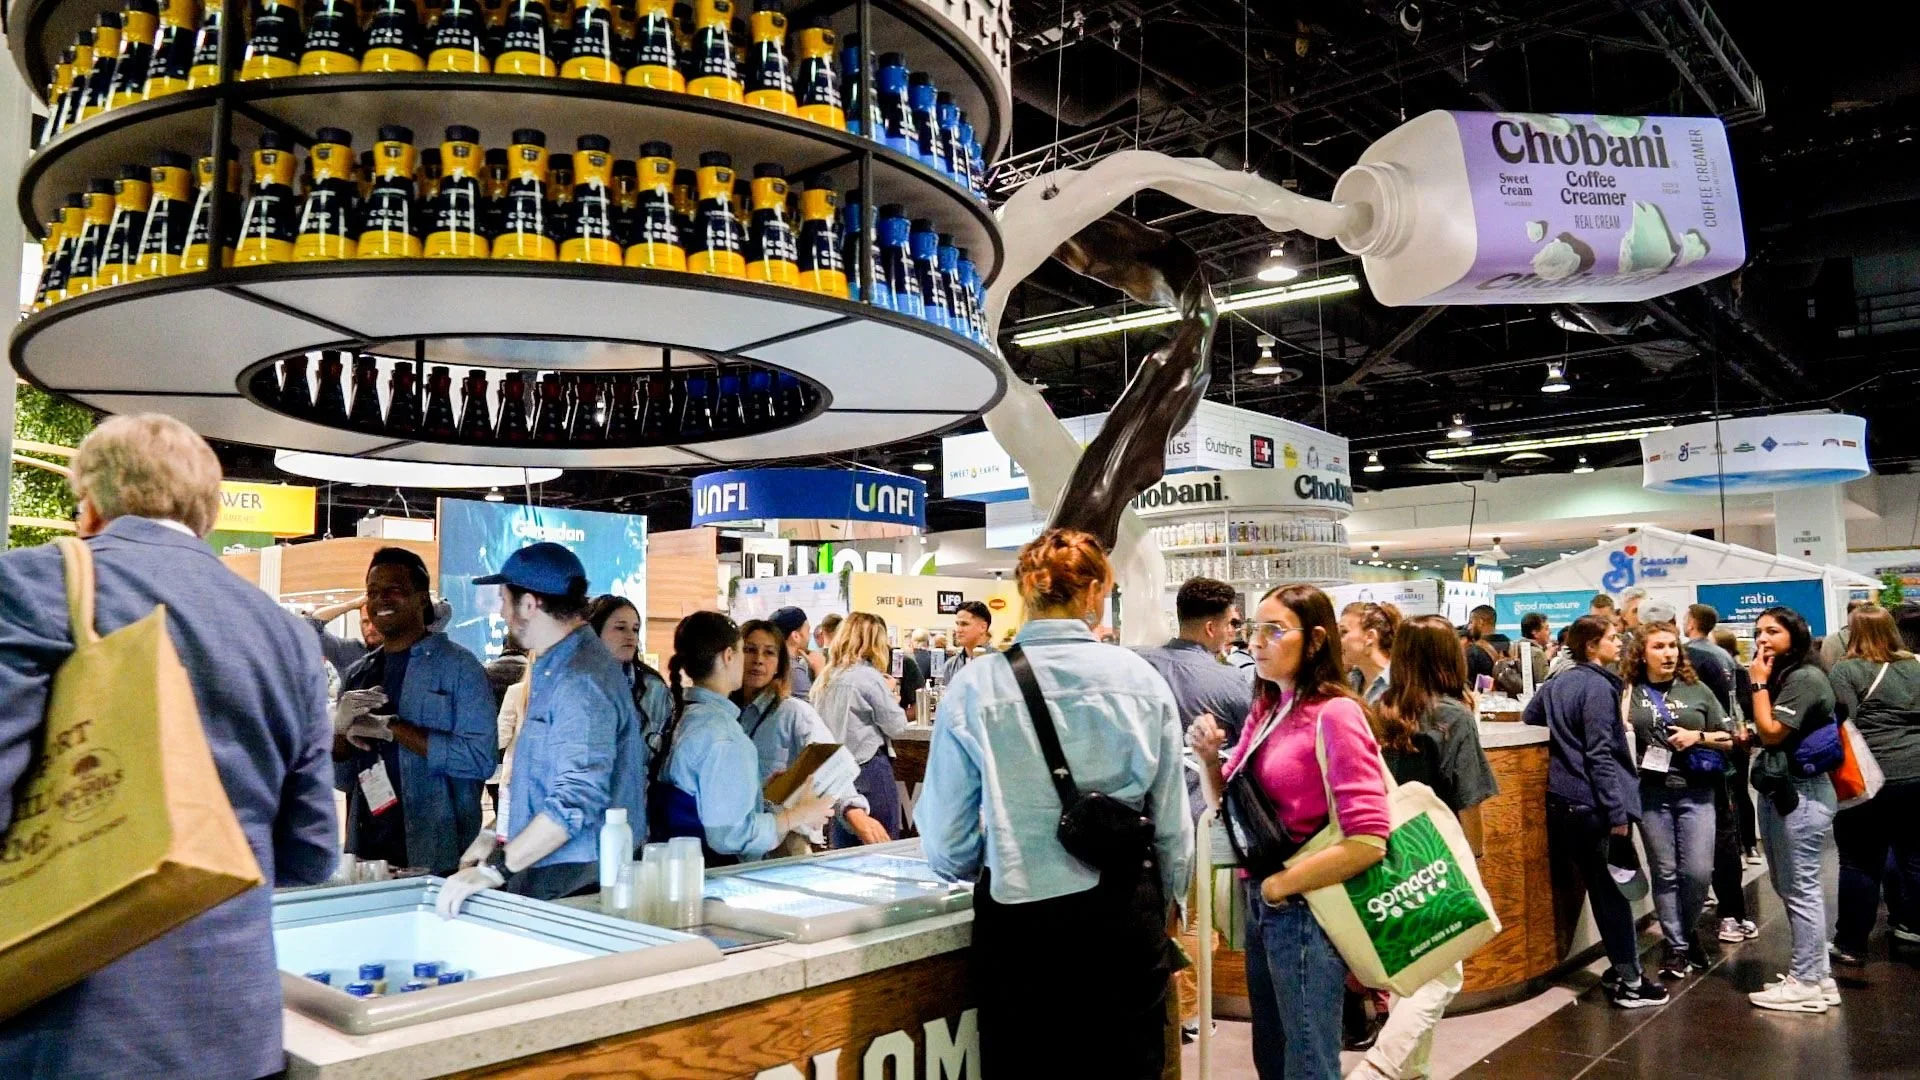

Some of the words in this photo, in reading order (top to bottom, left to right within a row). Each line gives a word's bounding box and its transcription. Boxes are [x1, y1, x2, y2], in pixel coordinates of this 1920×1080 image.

[437, 28, 471, 36] COLD
[1491, 120, 1670, 169] Chobani
[1499, 172, 1529, 185] Sweet
[1566, 170, 1616, 188] Coffee
[1499, 184, 1533, 196] Cream
[1560, 187, 1627, 206] Creamer
[1574, 214, 1593, 230] REAL
[1594, 214, 1621, 230] CREAM
[1166, 440, 1191, 455] liss
[220, 491, 262, 509] WER
[696, 482, 748, 517] UNFI
[855, 483, 915, 517] UNFI
[876, 596, 895, 606] SWEET
[905, 598, 923, 606] EARTH
[1367, 860, 1448, 922] gomacro
